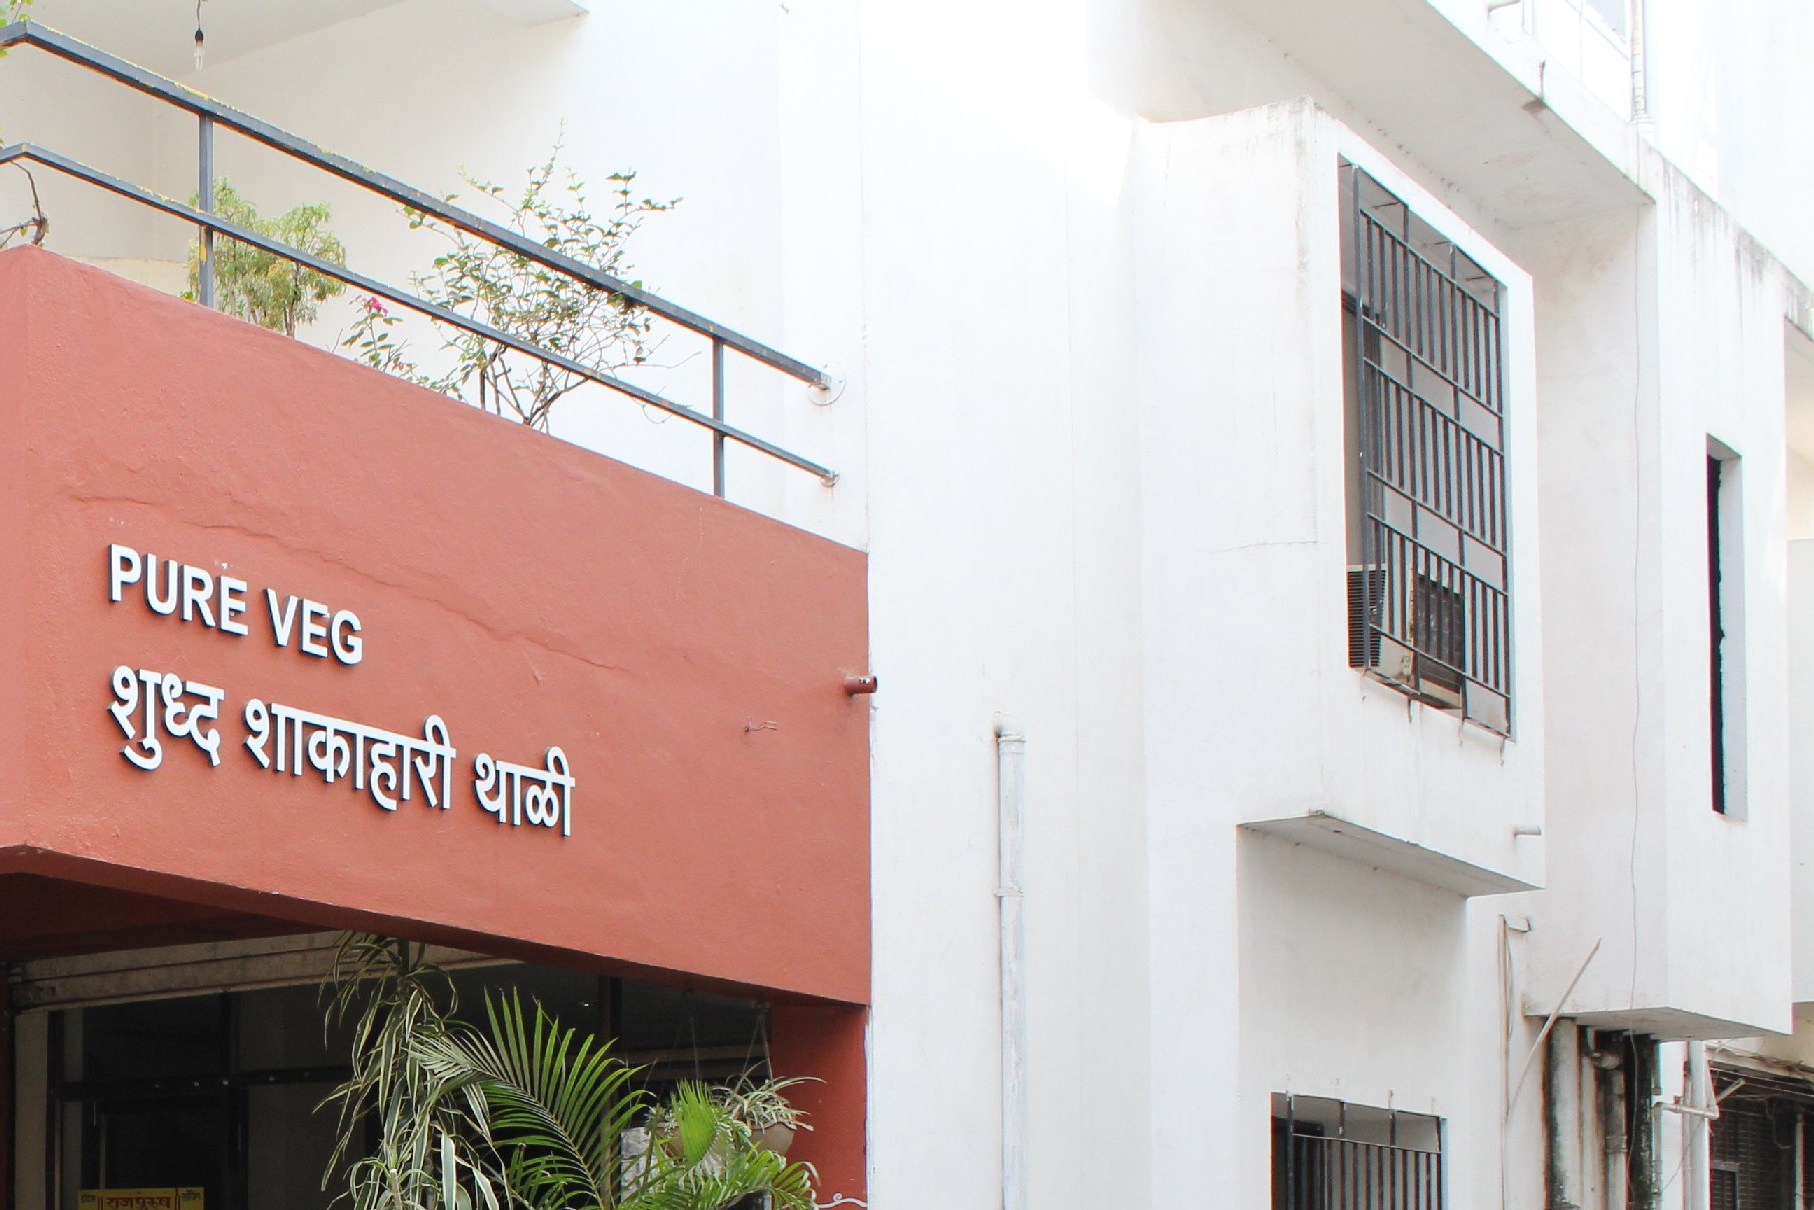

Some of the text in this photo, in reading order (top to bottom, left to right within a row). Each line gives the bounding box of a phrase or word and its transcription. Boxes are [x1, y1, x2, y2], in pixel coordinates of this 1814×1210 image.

[108, 543, 363, 665] PURE VEG
[244, 698, 457, 811] शाकाहारी
[474, 746, 576, 837] थाळी
